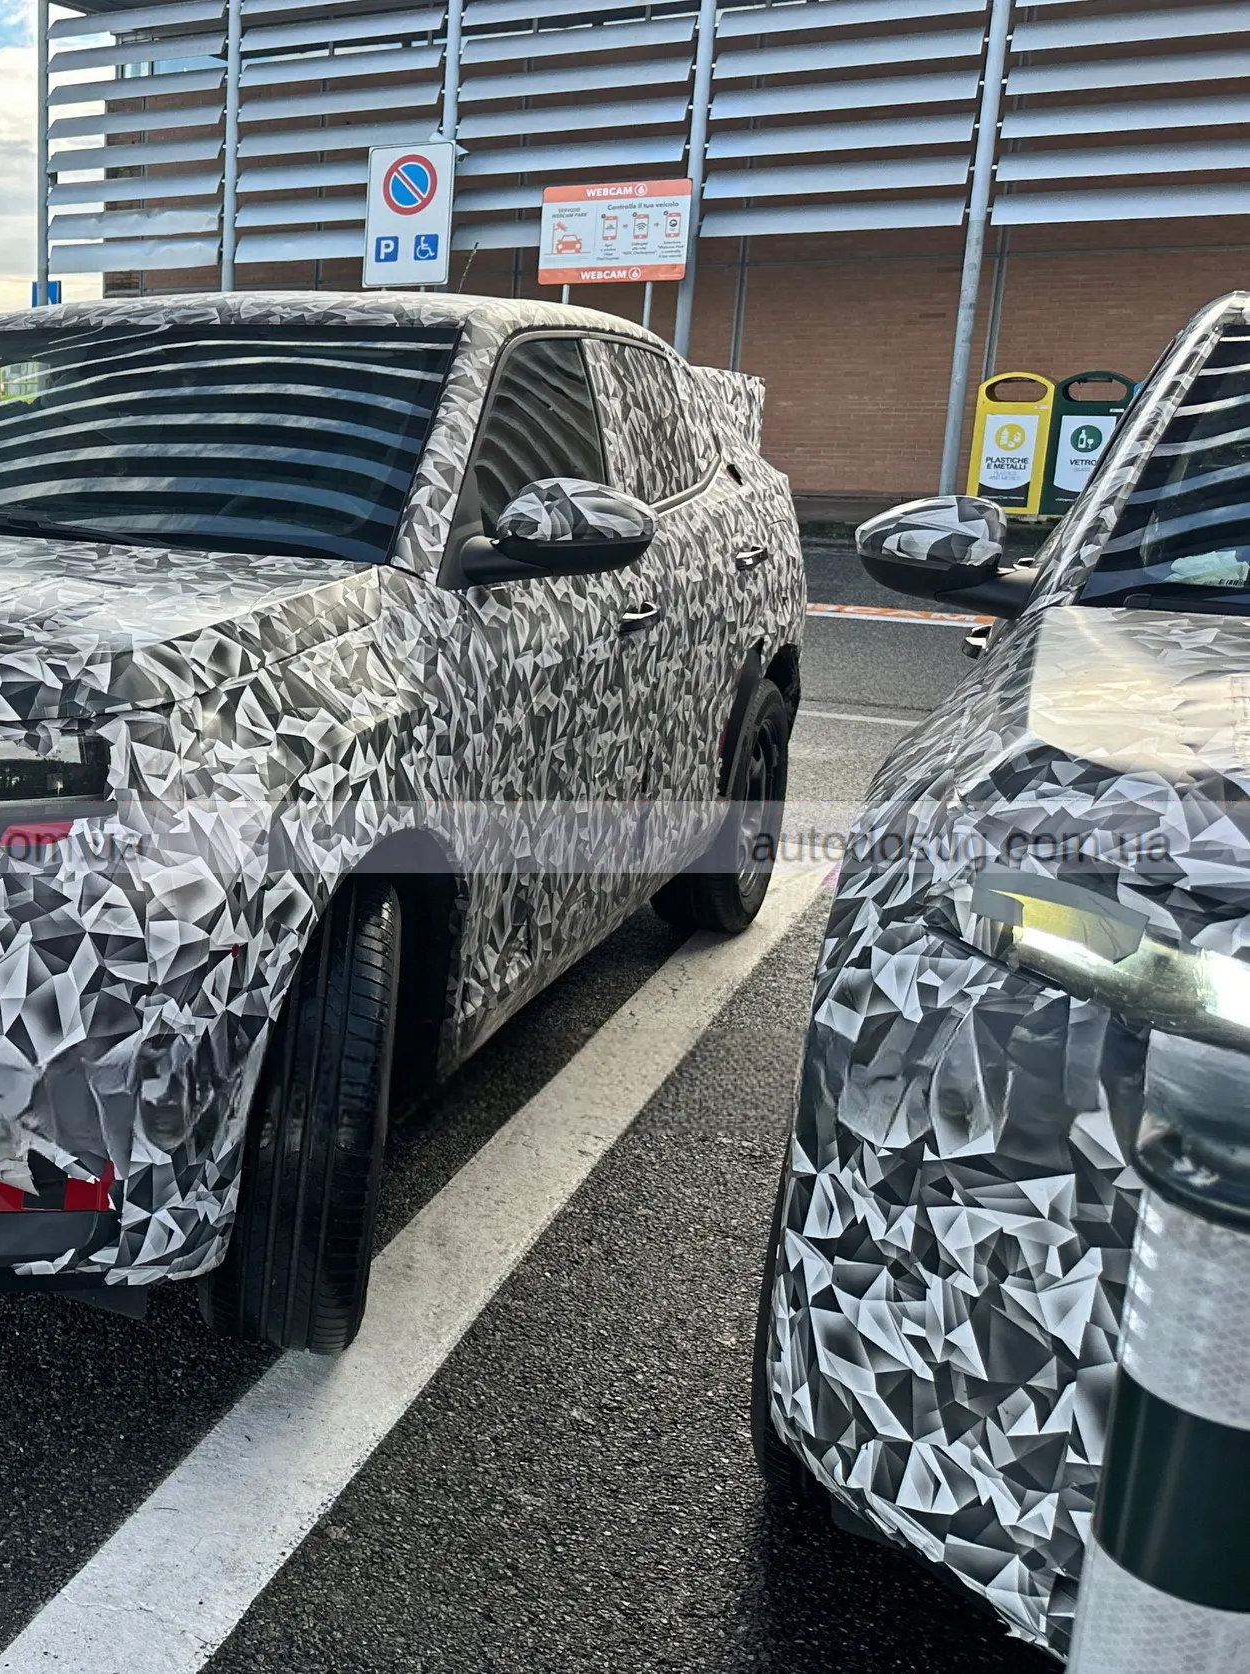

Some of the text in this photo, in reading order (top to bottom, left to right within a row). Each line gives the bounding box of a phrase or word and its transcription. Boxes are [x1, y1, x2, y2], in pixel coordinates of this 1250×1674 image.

[586, 186, 633, 197] WEBCAM
[380, 240, 395, 260] P
[581, 271, 627, 280] WEBCAM
